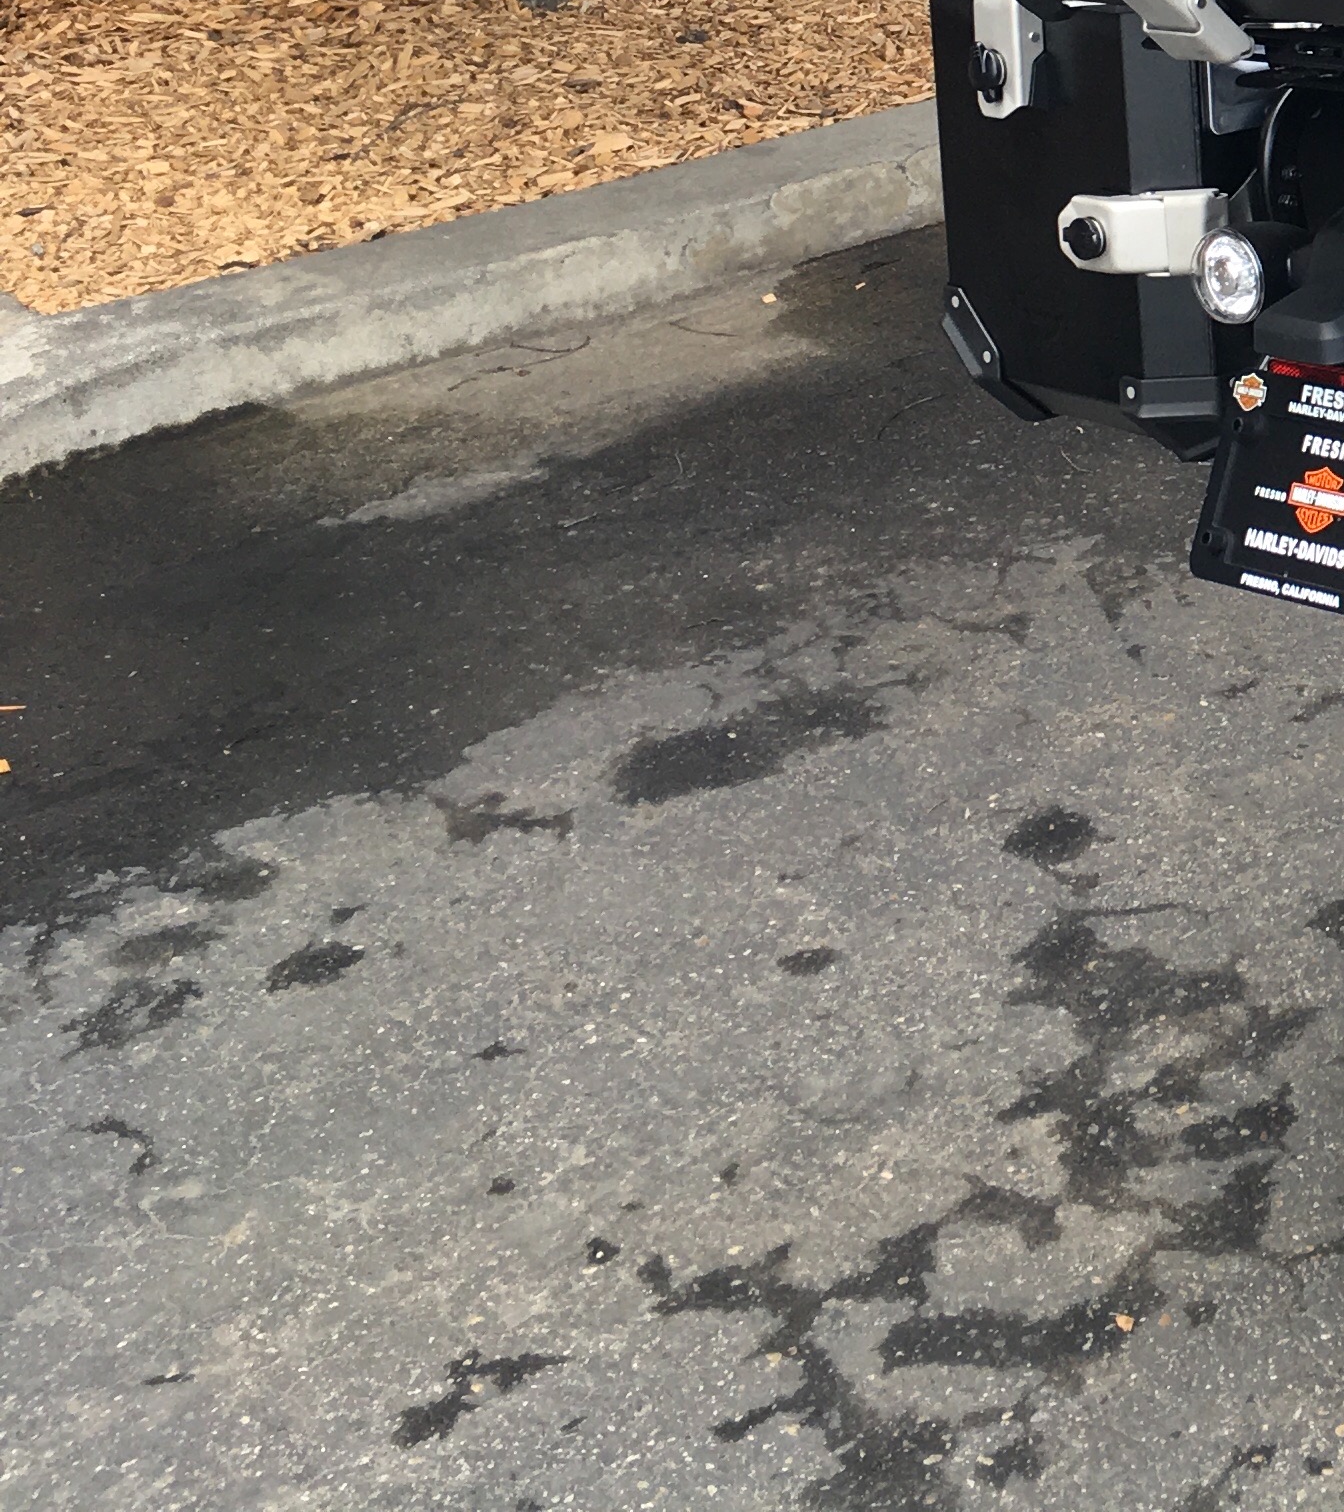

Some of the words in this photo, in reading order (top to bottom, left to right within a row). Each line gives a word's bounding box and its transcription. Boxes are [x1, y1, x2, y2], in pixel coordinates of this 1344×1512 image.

[1308, 472, 1338, 489] MOTOR
[1254, 485, 1287, 503] FRESNO
[1240, 572, 1280, 595] FRESNO,
[1281, 582, 1340, 609] CALIFORNIA
